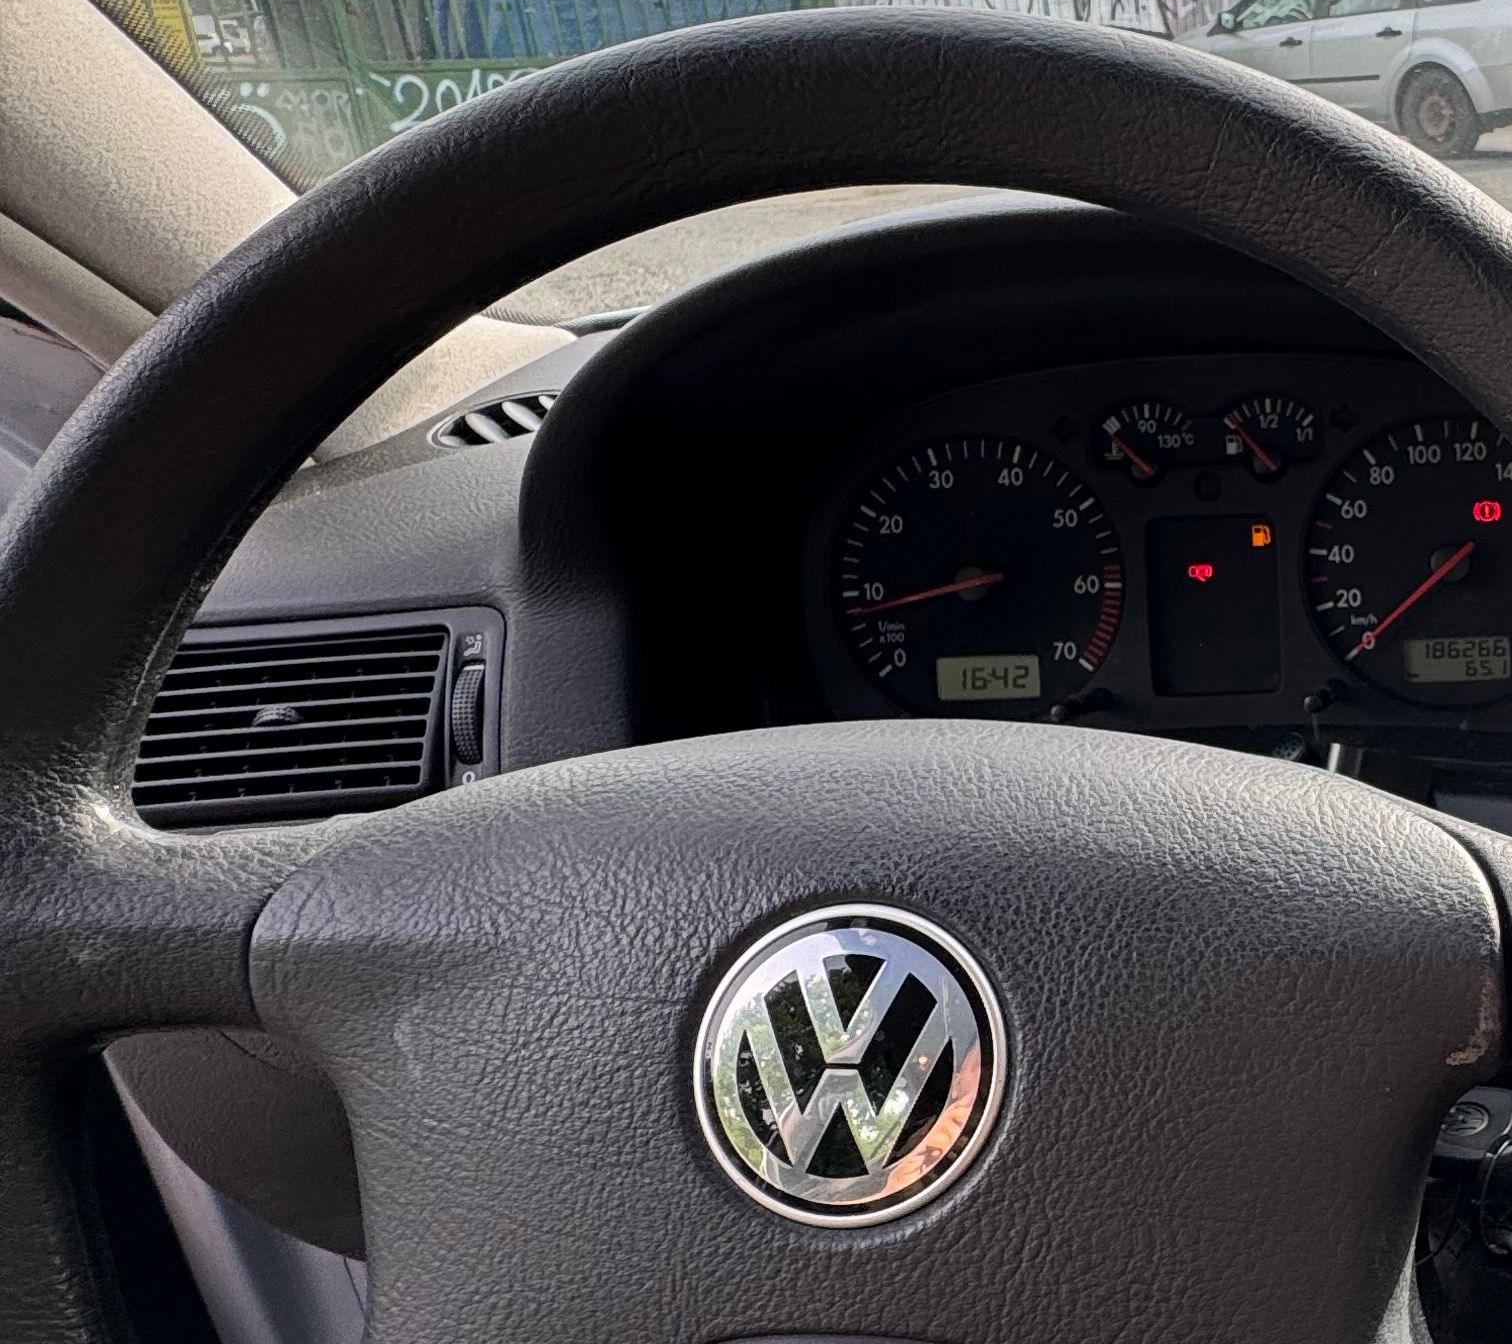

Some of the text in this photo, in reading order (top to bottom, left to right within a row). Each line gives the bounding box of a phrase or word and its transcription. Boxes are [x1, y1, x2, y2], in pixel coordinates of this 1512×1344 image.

[1138, 420, 1157, 434] 90
[1259, 414, 1279, 429] 1/2
[1407, 445, 1441, 464] 100
[1454, 442, 1487, 462] 120
[929, 470, 954, 489] 30
[998, 467, 1024, 487] 40
[1369, 466, 1395, 485] 80
[1052, 509, 1078, 528] 50
[1340, 499, 1367, 519] 60
[879, 515, 903, 534] 20
[1327, 544, 1355, 564] 40
[863, 582, 884, 601] 10
[1074, 574, 1100, 594] 60
[1336, 588, 1362, 608] 20
[1362, 631, 1375, 650] 0
[1425, 639, 1506, 659] 186266
[893, 647, 906, 667] 0
[1053, 641, 1077, 661] 70
[961, 664, 1030, 691] 16:42
